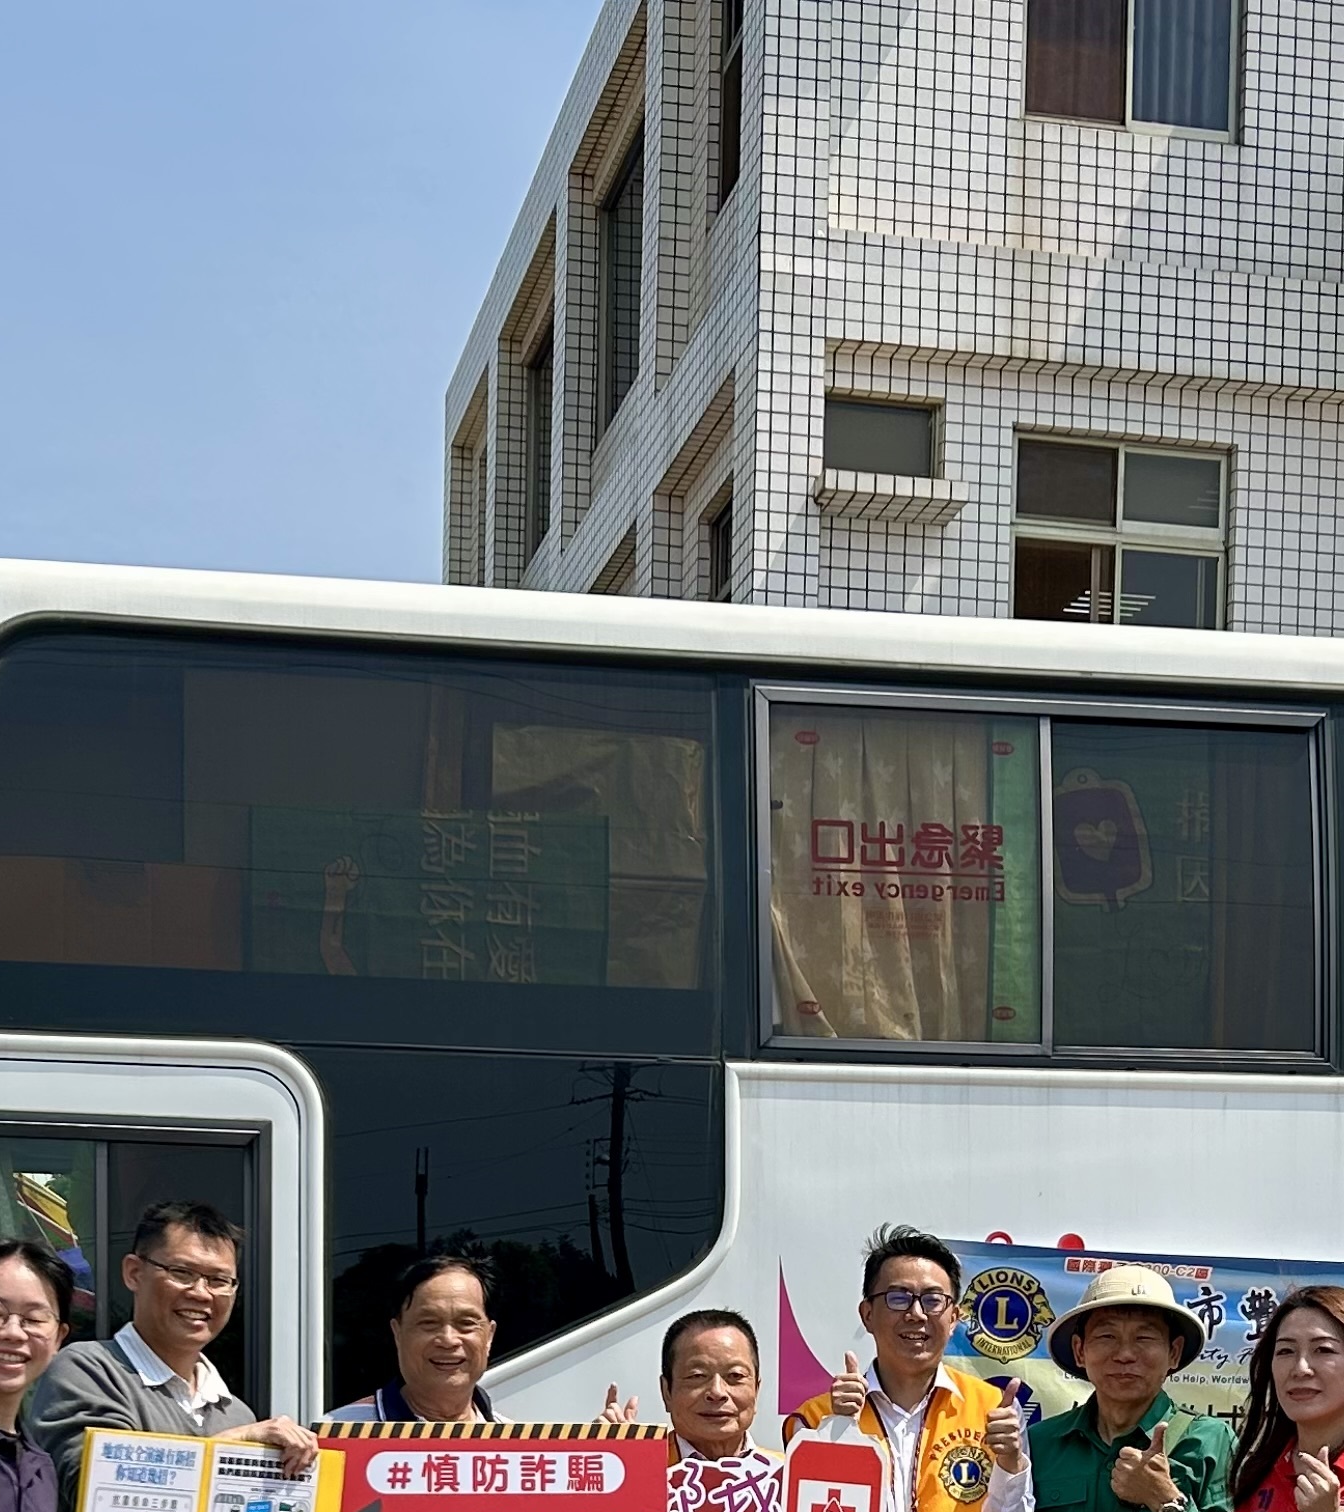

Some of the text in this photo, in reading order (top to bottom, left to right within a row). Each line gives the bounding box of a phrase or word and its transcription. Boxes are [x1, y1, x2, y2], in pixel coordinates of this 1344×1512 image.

[977, 1270, 1036, 1292] LIONS
[994, 1296, 1019, 1330] L
[975, 1337, 1034, 1356] INTERNATIONAL
[1211, 1375, 1251, 1386] Worldw
[929, 1428, 989, 1461] PRESIDE
[386, 1454, 605, 1494] #慎防詐騙
[960, 1464, 976, 1484] L
